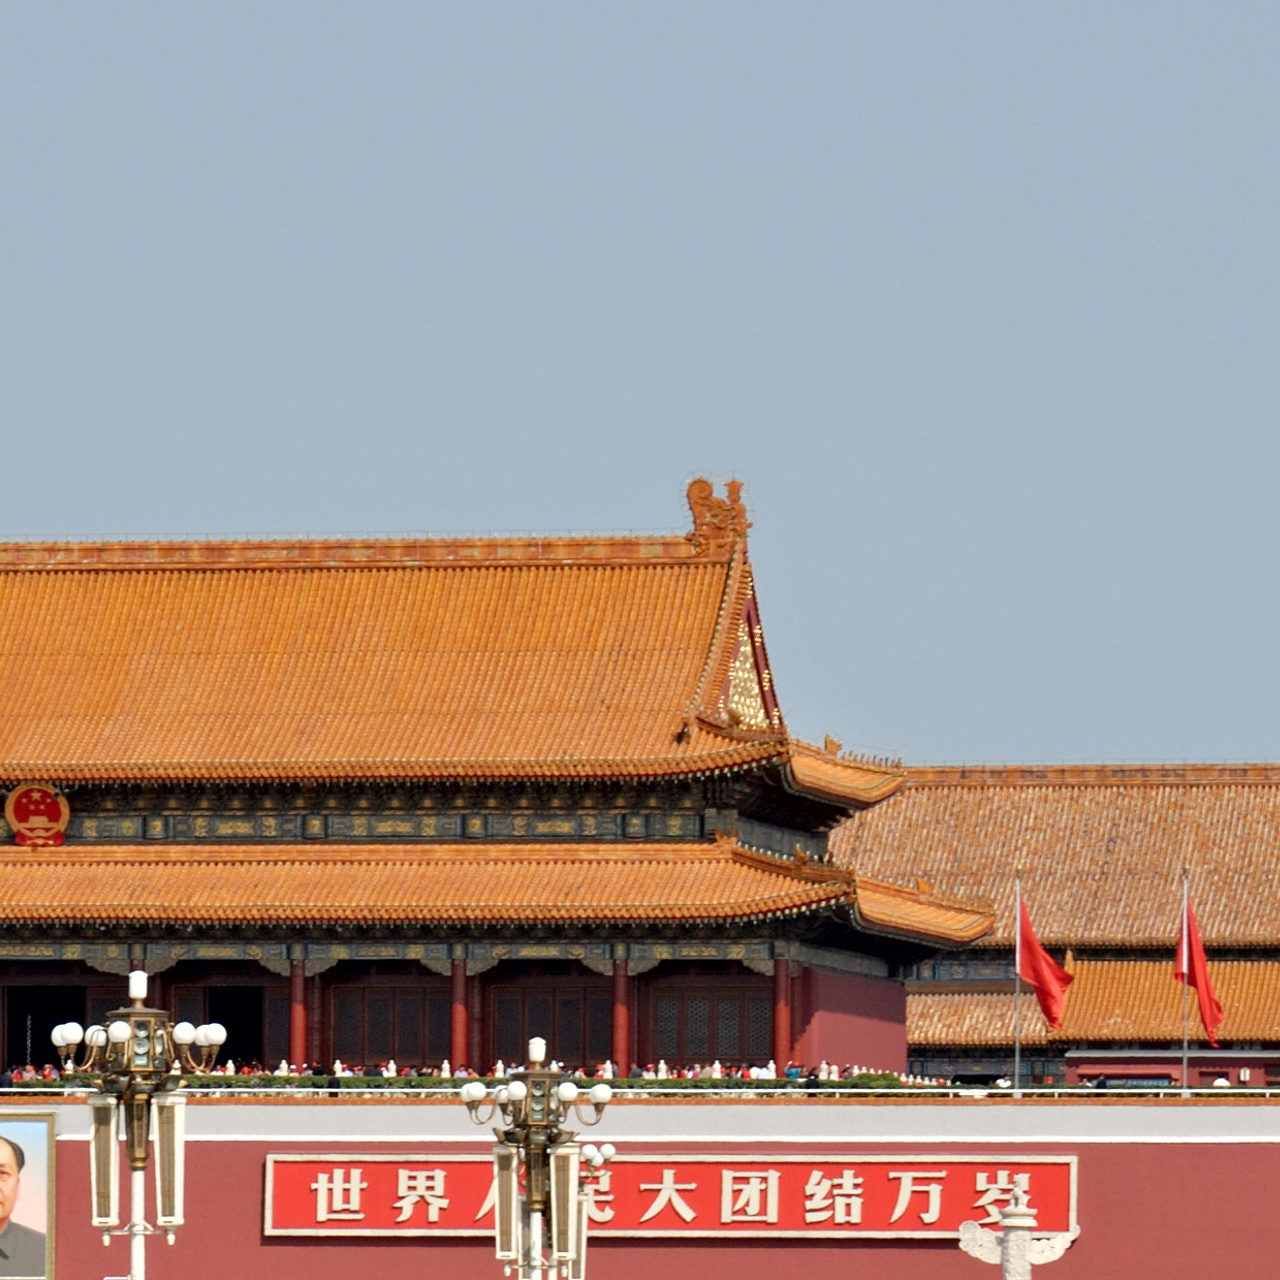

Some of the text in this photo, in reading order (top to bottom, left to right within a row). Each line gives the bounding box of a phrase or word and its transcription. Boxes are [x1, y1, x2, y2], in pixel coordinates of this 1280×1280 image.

[310, 1168, 1032, 1225] 世界民大团结万岁
